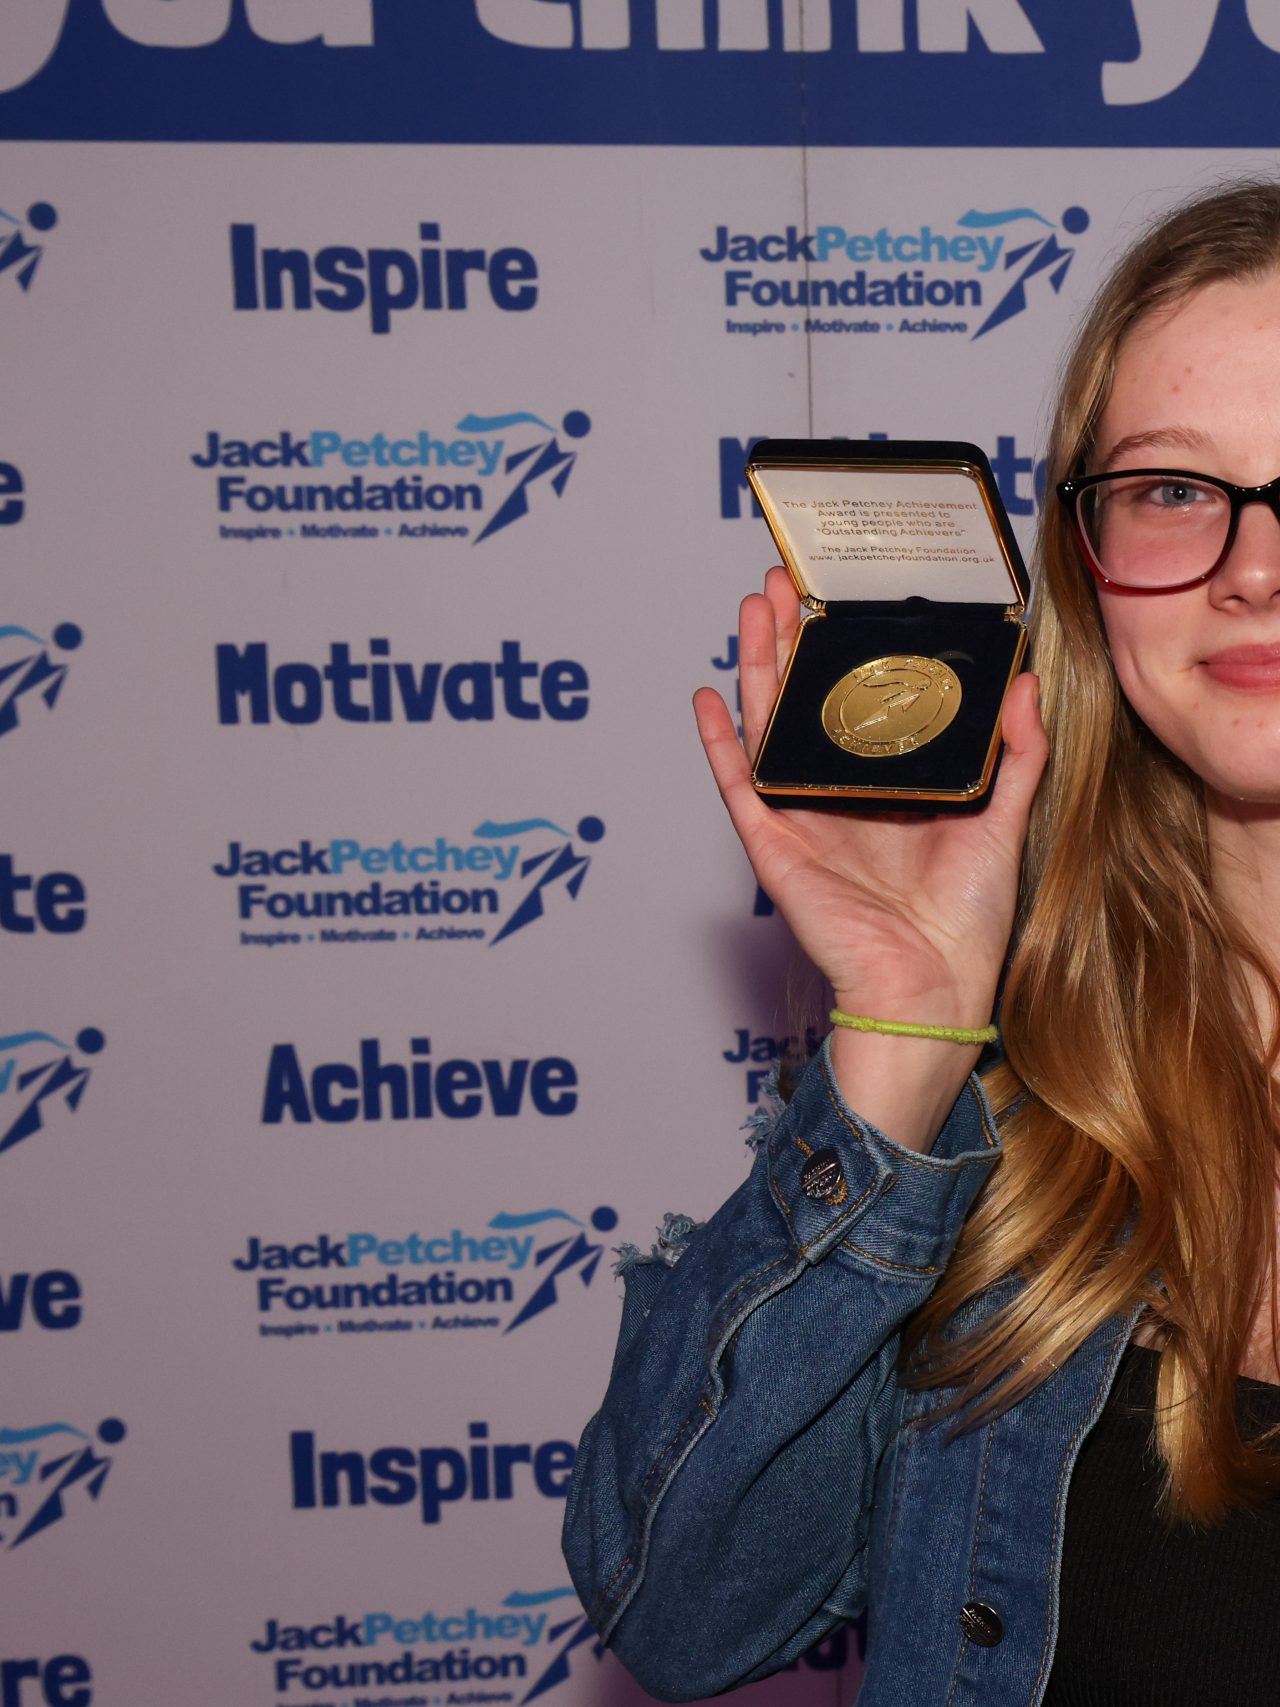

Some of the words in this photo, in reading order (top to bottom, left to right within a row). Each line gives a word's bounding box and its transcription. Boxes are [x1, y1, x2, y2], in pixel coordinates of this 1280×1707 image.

[230, 223, 537, 334] Inspire
[724, 270, 982, 307] Foundation
[726, 319, 785, 334] Inspire
[805, 318, 881, 333] Motivate
[898, 318, 968, 333] Achieve
[217, 475, 483, 512] Foundation
[811, 500, 840, 508] Jack
[842, 499, 893, 509] Petchey
[896, 500, 977, 510] Achievement
[219, 525, 283, 542] Inspire
[300, 523, 379, 539] Motivate
[397, 523, 469, 538] Achieve
[820, 520, 859, 528] young
[861, 520, 903, 528] people
[873, 510, 936, 519] presented
[870, 546, 913, 554] Petchey
[915, 546, 977, 555] Foundation
[216, 639, 589, 725] Motivate
[239, 879, 502, 919] Foundation
[262, 1038, 577, 1124] Achieve
[258, 1272, 513, 1312] Foundation
[289, 1422, 577, 1524] Inspire
[274, 1649, 527, 1692] Foundation
